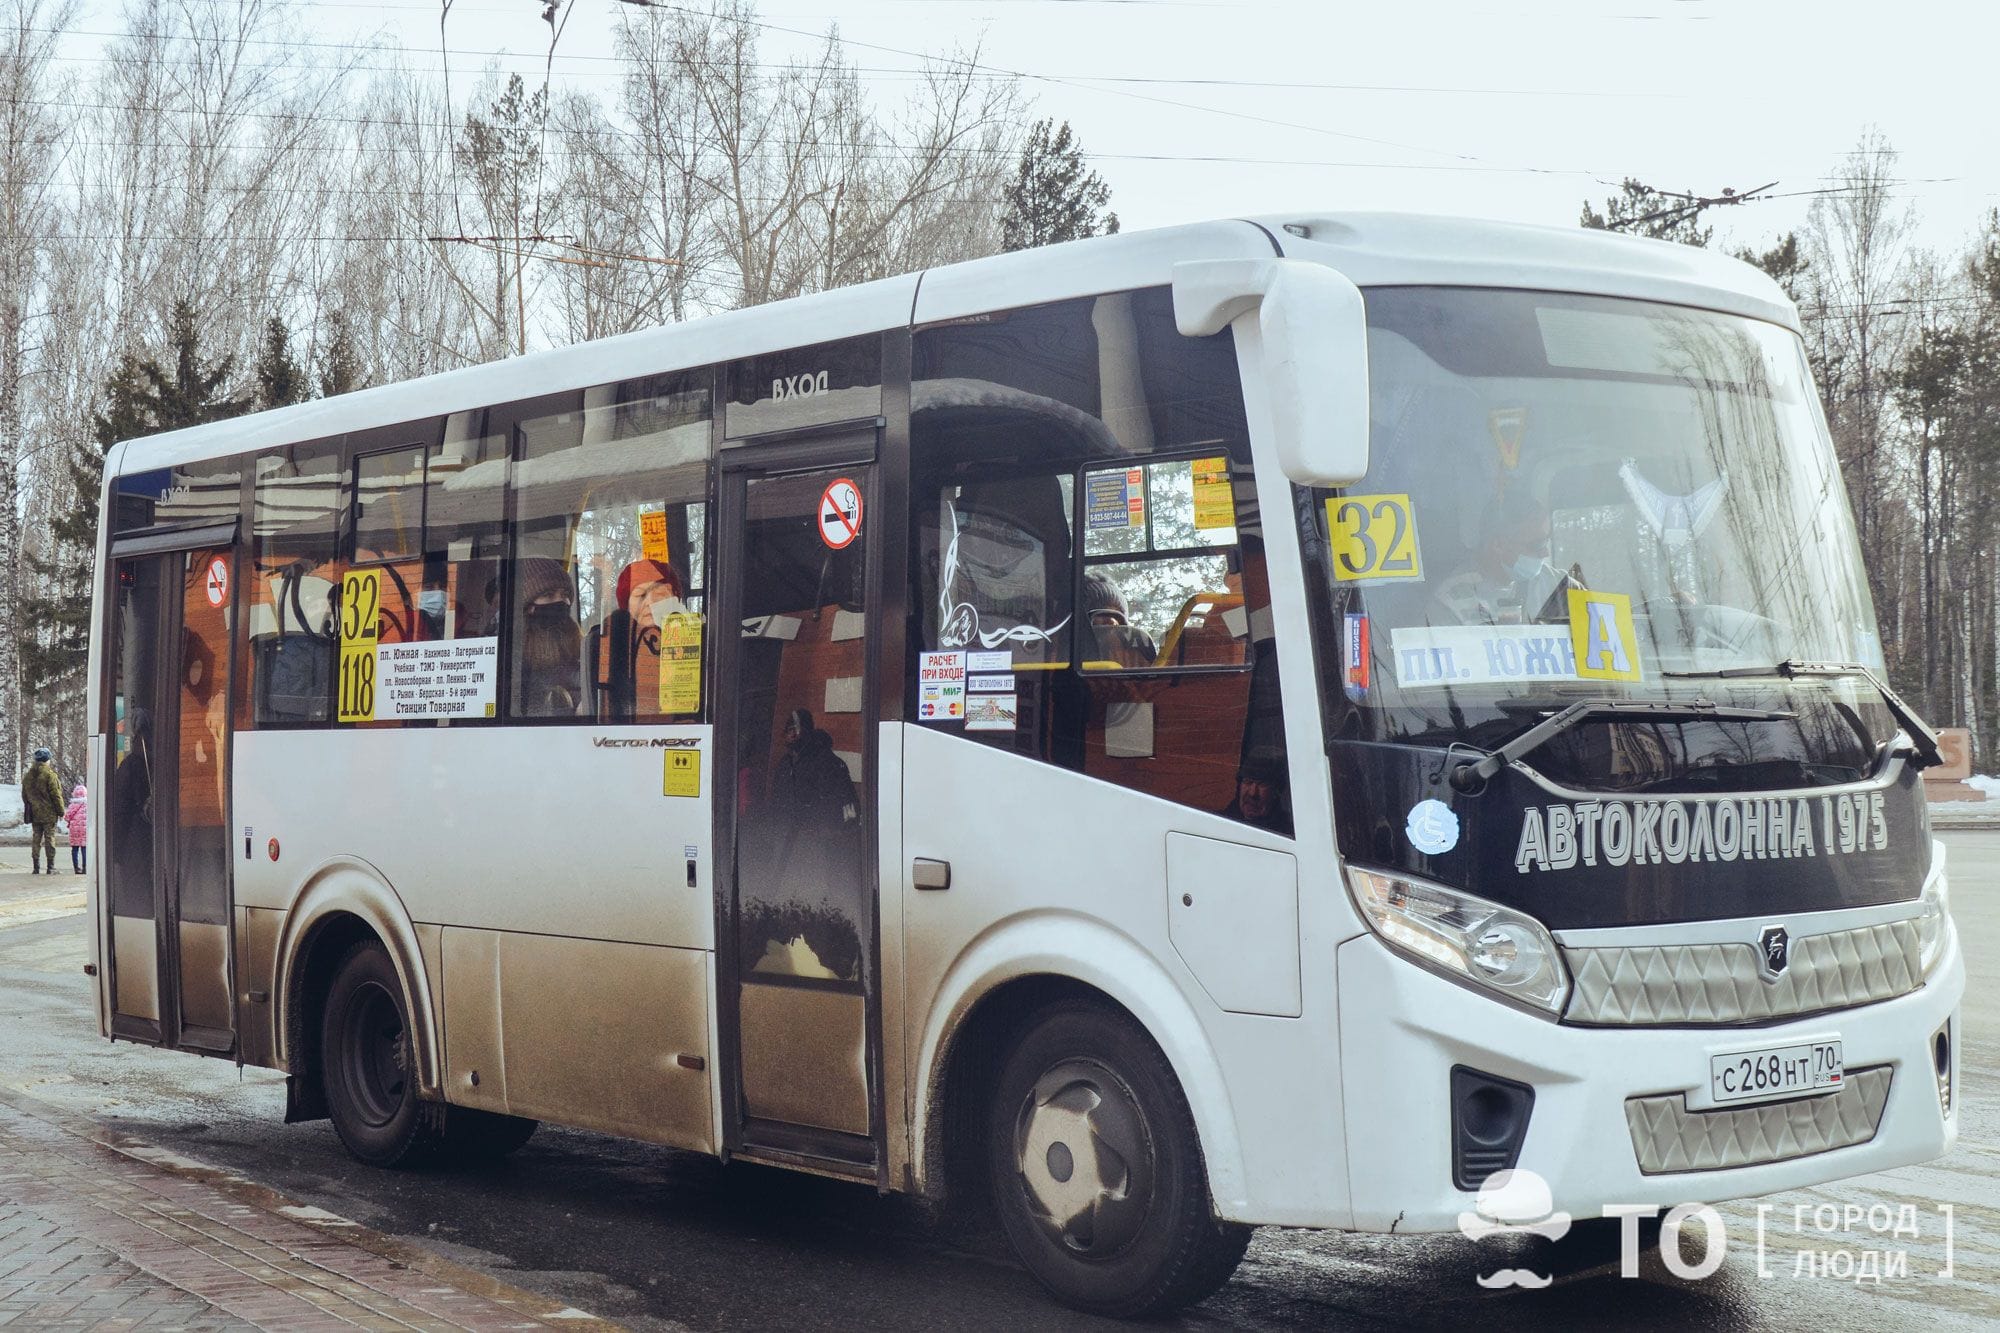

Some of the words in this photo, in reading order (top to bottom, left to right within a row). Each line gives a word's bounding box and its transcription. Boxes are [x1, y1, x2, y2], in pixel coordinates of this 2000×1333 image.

[772, 370, 829, 404] ВХОД
[1337, 499, 1411, 577] 32
[344, 574, 378, 641] 32
[1586, 601, 1631, 672] А
[380, 650, 391, 661] пл.
[393, 648, 419, 660] Южная
[424, 648, 451, 658] Нахимова
[455, 645, 484, 658] Лагерный
[484, 646, 496, 655] сад
[928, 654, 958, 666] РАСЧЕТ
[393, 663, 415, 673] Учебная
[420, 661, 435, 672] ТЭМЗ
[440, 661, 476, 672] Университет
[921, 669, 937, 680] ПРИ
[939, 667, 964, 680] ВХОДЕ
[340, 651, 375, 717] 118
[394, 675, 432, 687] Новособорная
[446, 674, 467, 684] Ленина
[471, 672, 485, 684] ЦУМ
[397, 689, 415, 699] Рынок
[418, 688, 445, 700] Бердская
[943, 687, 962, 696] МИР
[396, 702, 427, 714] Станция
[429, 701, 466, 715] Товарная
[650, 738, 701, 748] NEXT
[1515, 797, 1815, 875] АВТОКОЛОННА
[1821, 790, 1889, 856] 1975
[1815, 1046, 1835, 1072] 70
[1815, 1073, 1830, 1082] RUS
